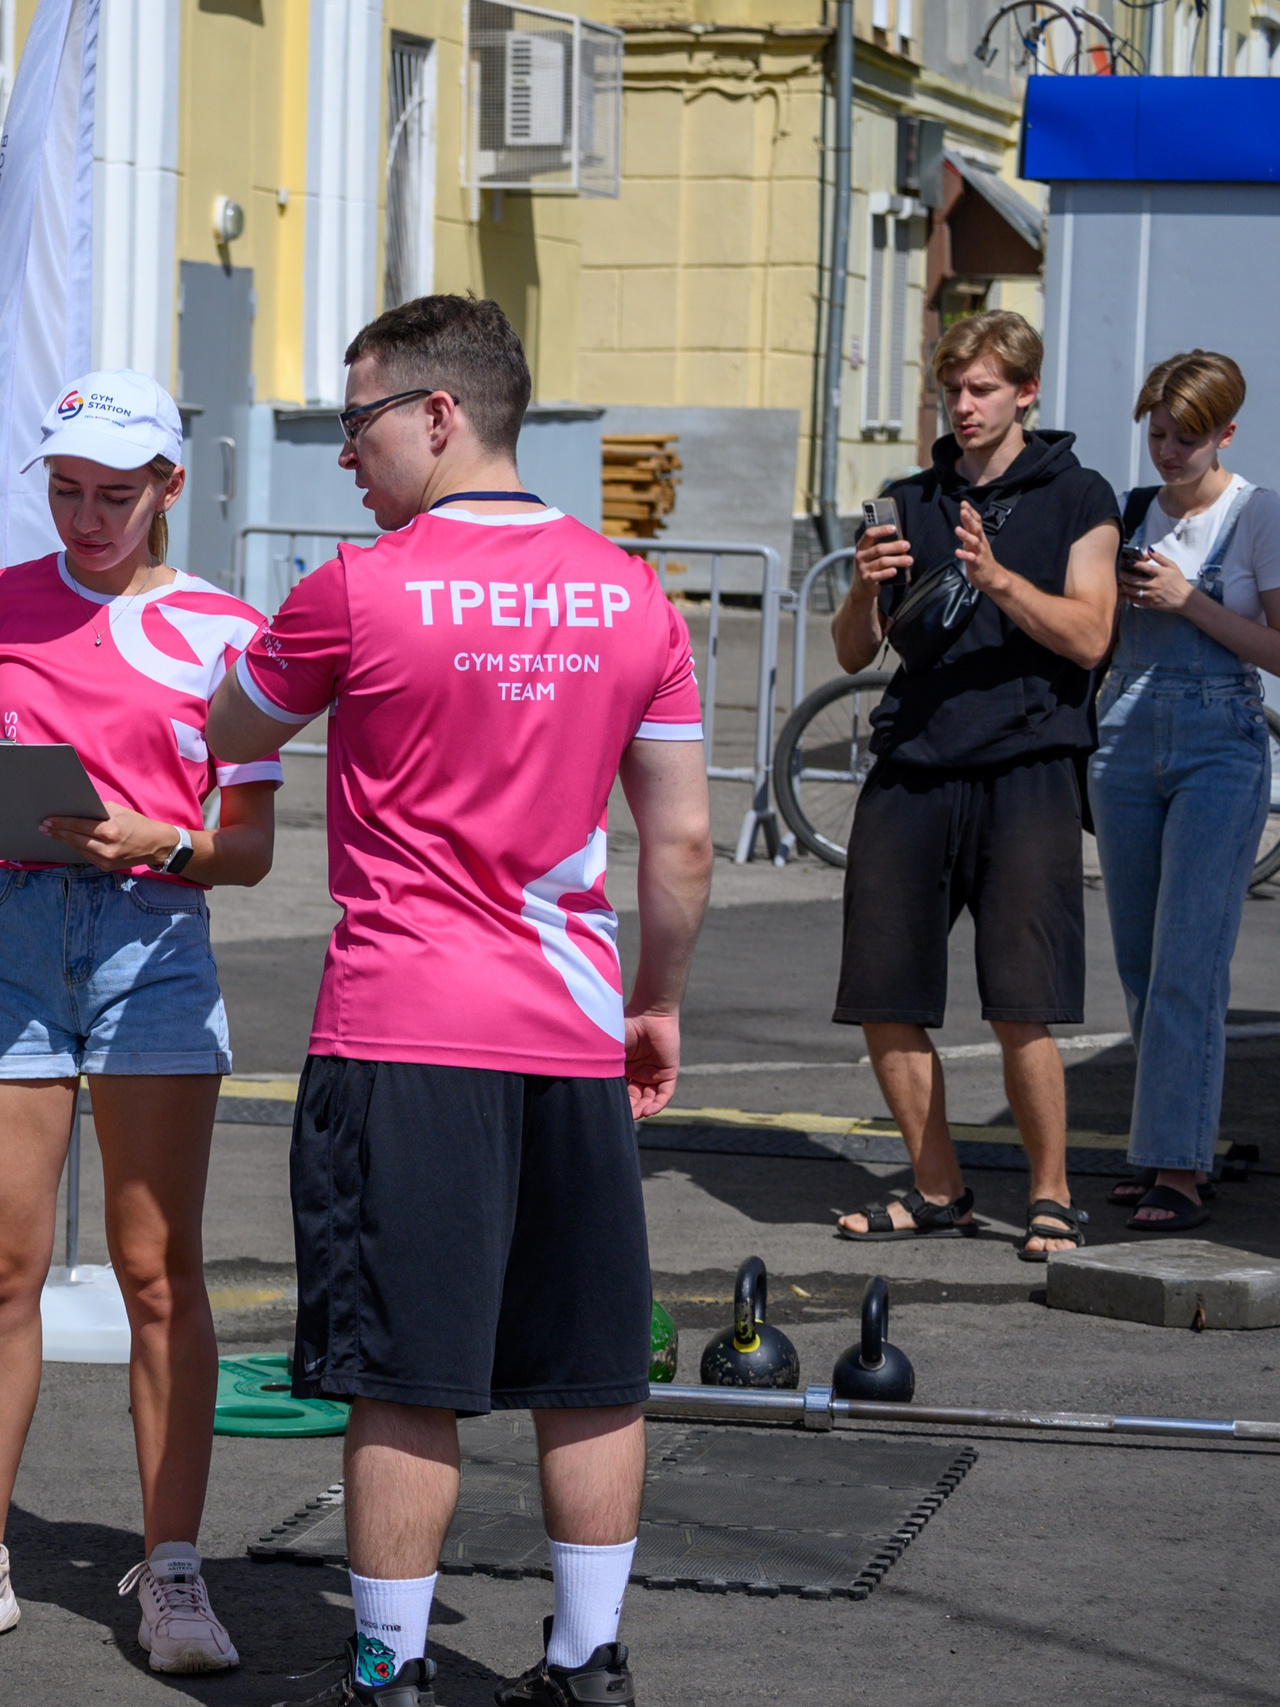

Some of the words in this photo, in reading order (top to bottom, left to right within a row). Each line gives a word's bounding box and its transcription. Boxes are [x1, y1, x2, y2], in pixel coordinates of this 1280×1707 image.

[90, 393, 114, 404] GYM
[87, 401, 132, 418] STATION
[405, 580, 631, 628] ТРЕНЕР
[453, 652, 504, 672] GYM
[508, 653, 600, 673] STATION
[497, 682, 555, 701] TEAM
